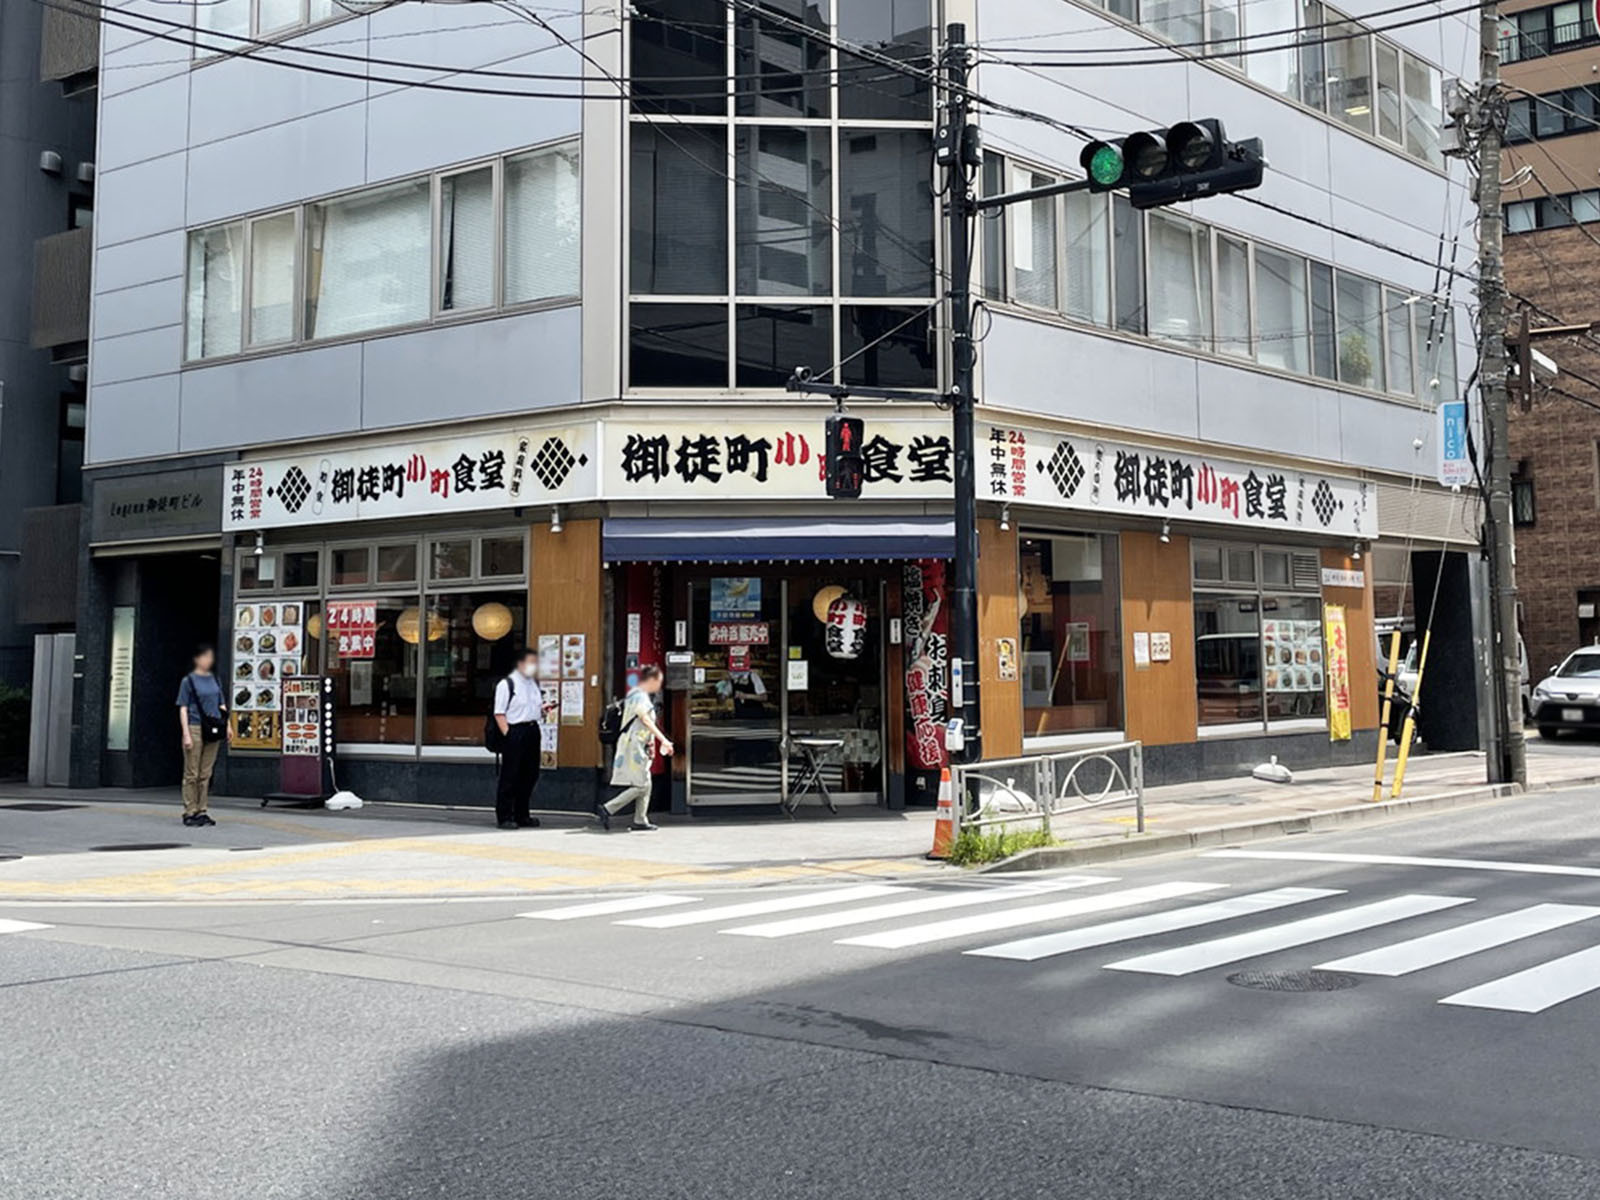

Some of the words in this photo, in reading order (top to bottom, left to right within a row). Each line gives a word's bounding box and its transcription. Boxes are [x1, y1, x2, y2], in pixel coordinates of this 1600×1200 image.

[331, 450, 506, 504] 御徒町小町食堂
[621, 430, 954, 484] 御徒町小食堂
[989, 428, 1007, 495] 年中無休
[1008, 430, 1026, 497] 24時間営業
[1114, 450, 1288, 521] 御徒町小町食堂
[231, 469, 246, 521] 年中無休
[248, 467, 264, 519] 24時間営業
[926, 632, 948, 725] お刺身
